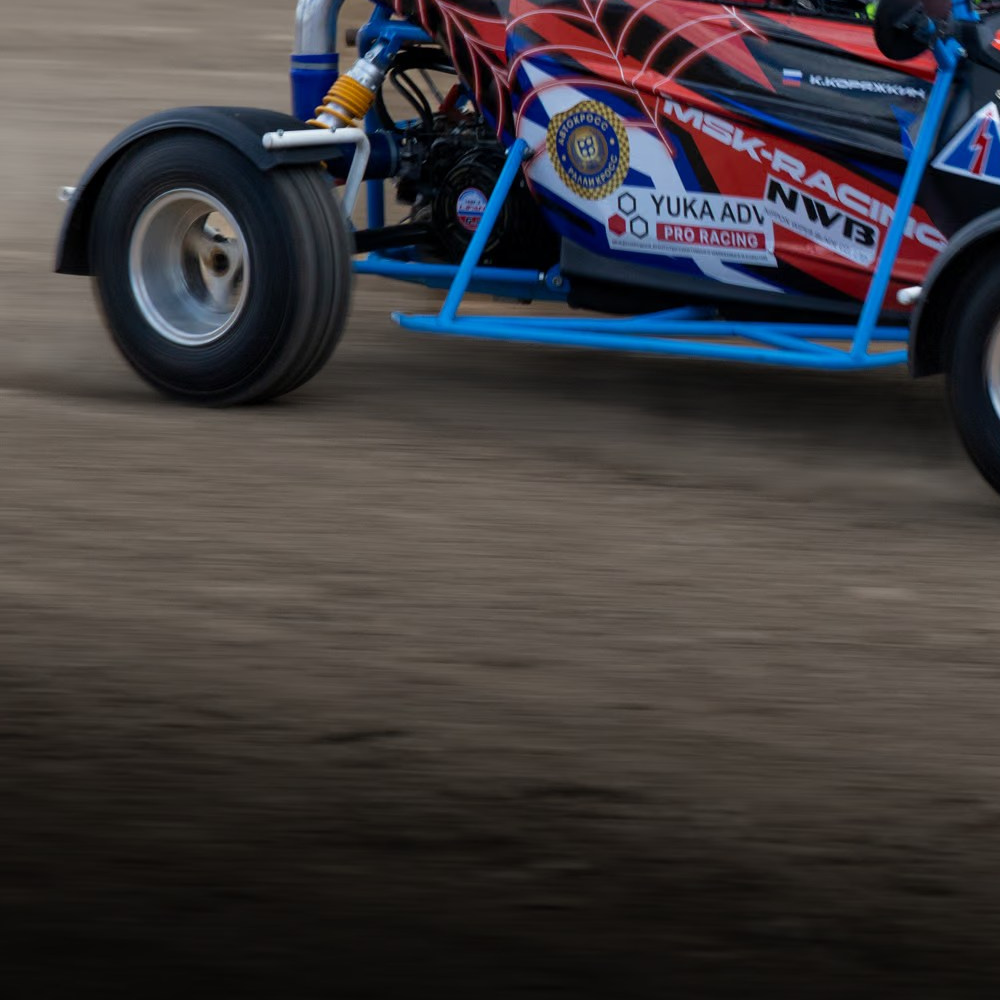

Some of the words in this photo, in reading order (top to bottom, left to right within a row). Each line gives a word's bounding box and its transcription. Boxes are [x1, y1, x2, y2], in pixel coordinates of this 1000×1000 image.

[558, 113, 609, 146] АВТОКРОСС
[568, 154, 618, 187] РАЛЛИКРОСС
[651, 193, 715, 223] YUKA
[720, 201, 765, 226] ADV
[767, 179, 876, 247] NWB
[664, 226, 695, 243] PRO
[700, 230, 759, 250] RACING
